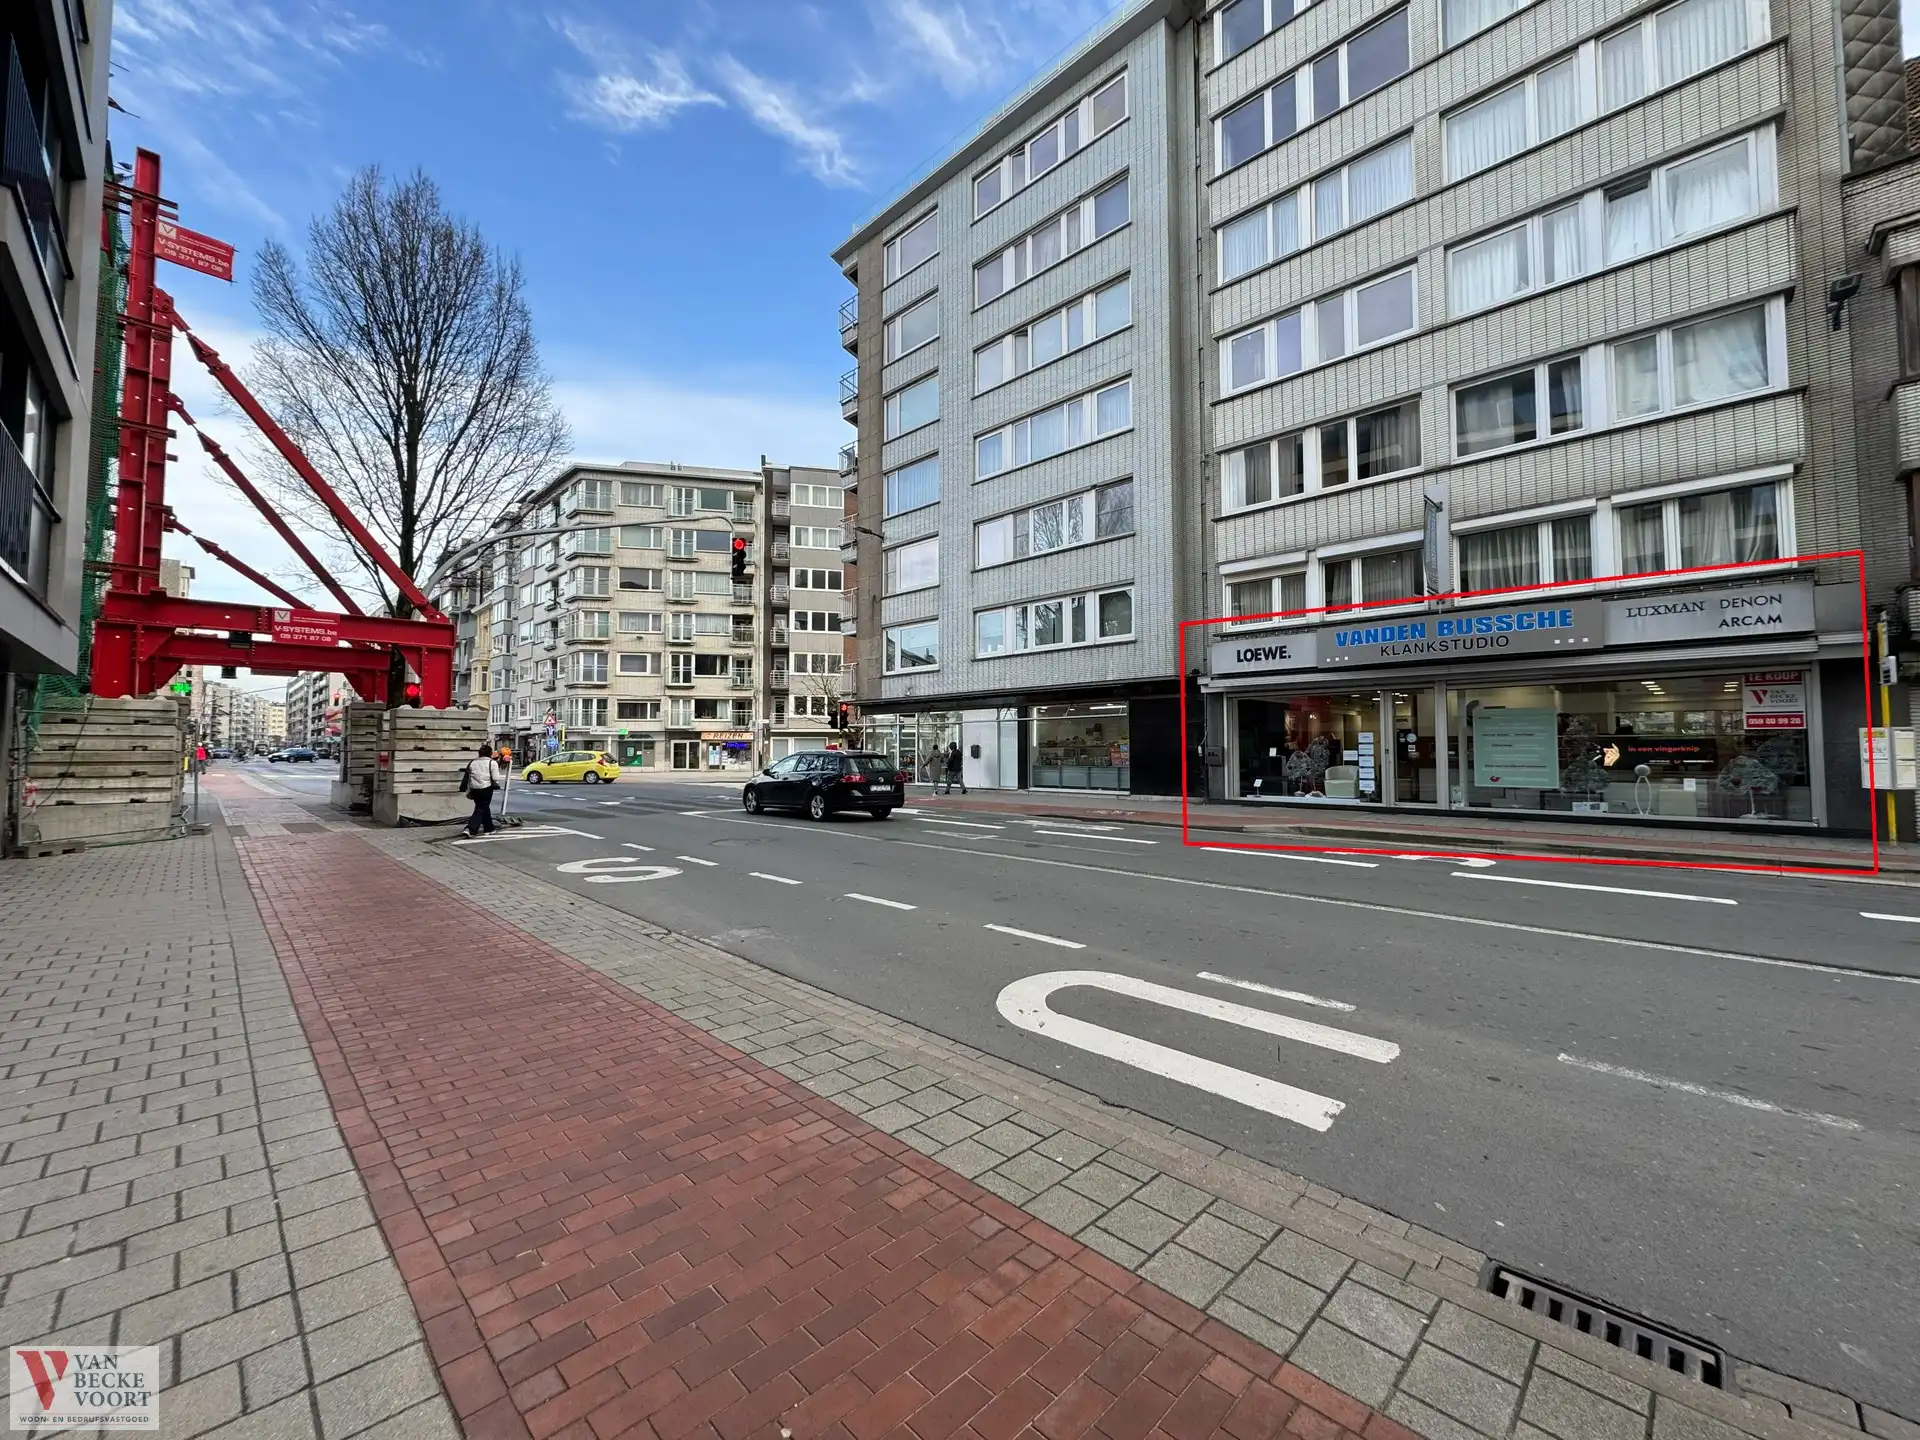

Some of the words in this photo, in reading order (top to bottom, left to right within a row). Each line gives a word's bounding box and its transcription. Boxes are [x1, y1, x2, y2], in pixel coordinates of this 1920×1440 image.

[157, 236, 230, 268] V-SYSTEMS.be
[1625, 600, 1706, 618] LUXMAN
[1720, 594, 1782, 609] DENON
[274, 625, 338, 636] V-SYSTEMS.be
[1335, 622, 1426, 648] VANDEN
[1437, 609, 1574, 637] BUSSCHE
[1718, 614, 1783, 628] ARCAM
[1236, 645, 1292, 663] LOEWE.
[1380, 635, 1509, 657] KLANKSTUDIO
[1654, 745, 1700, 753] vingerknip
